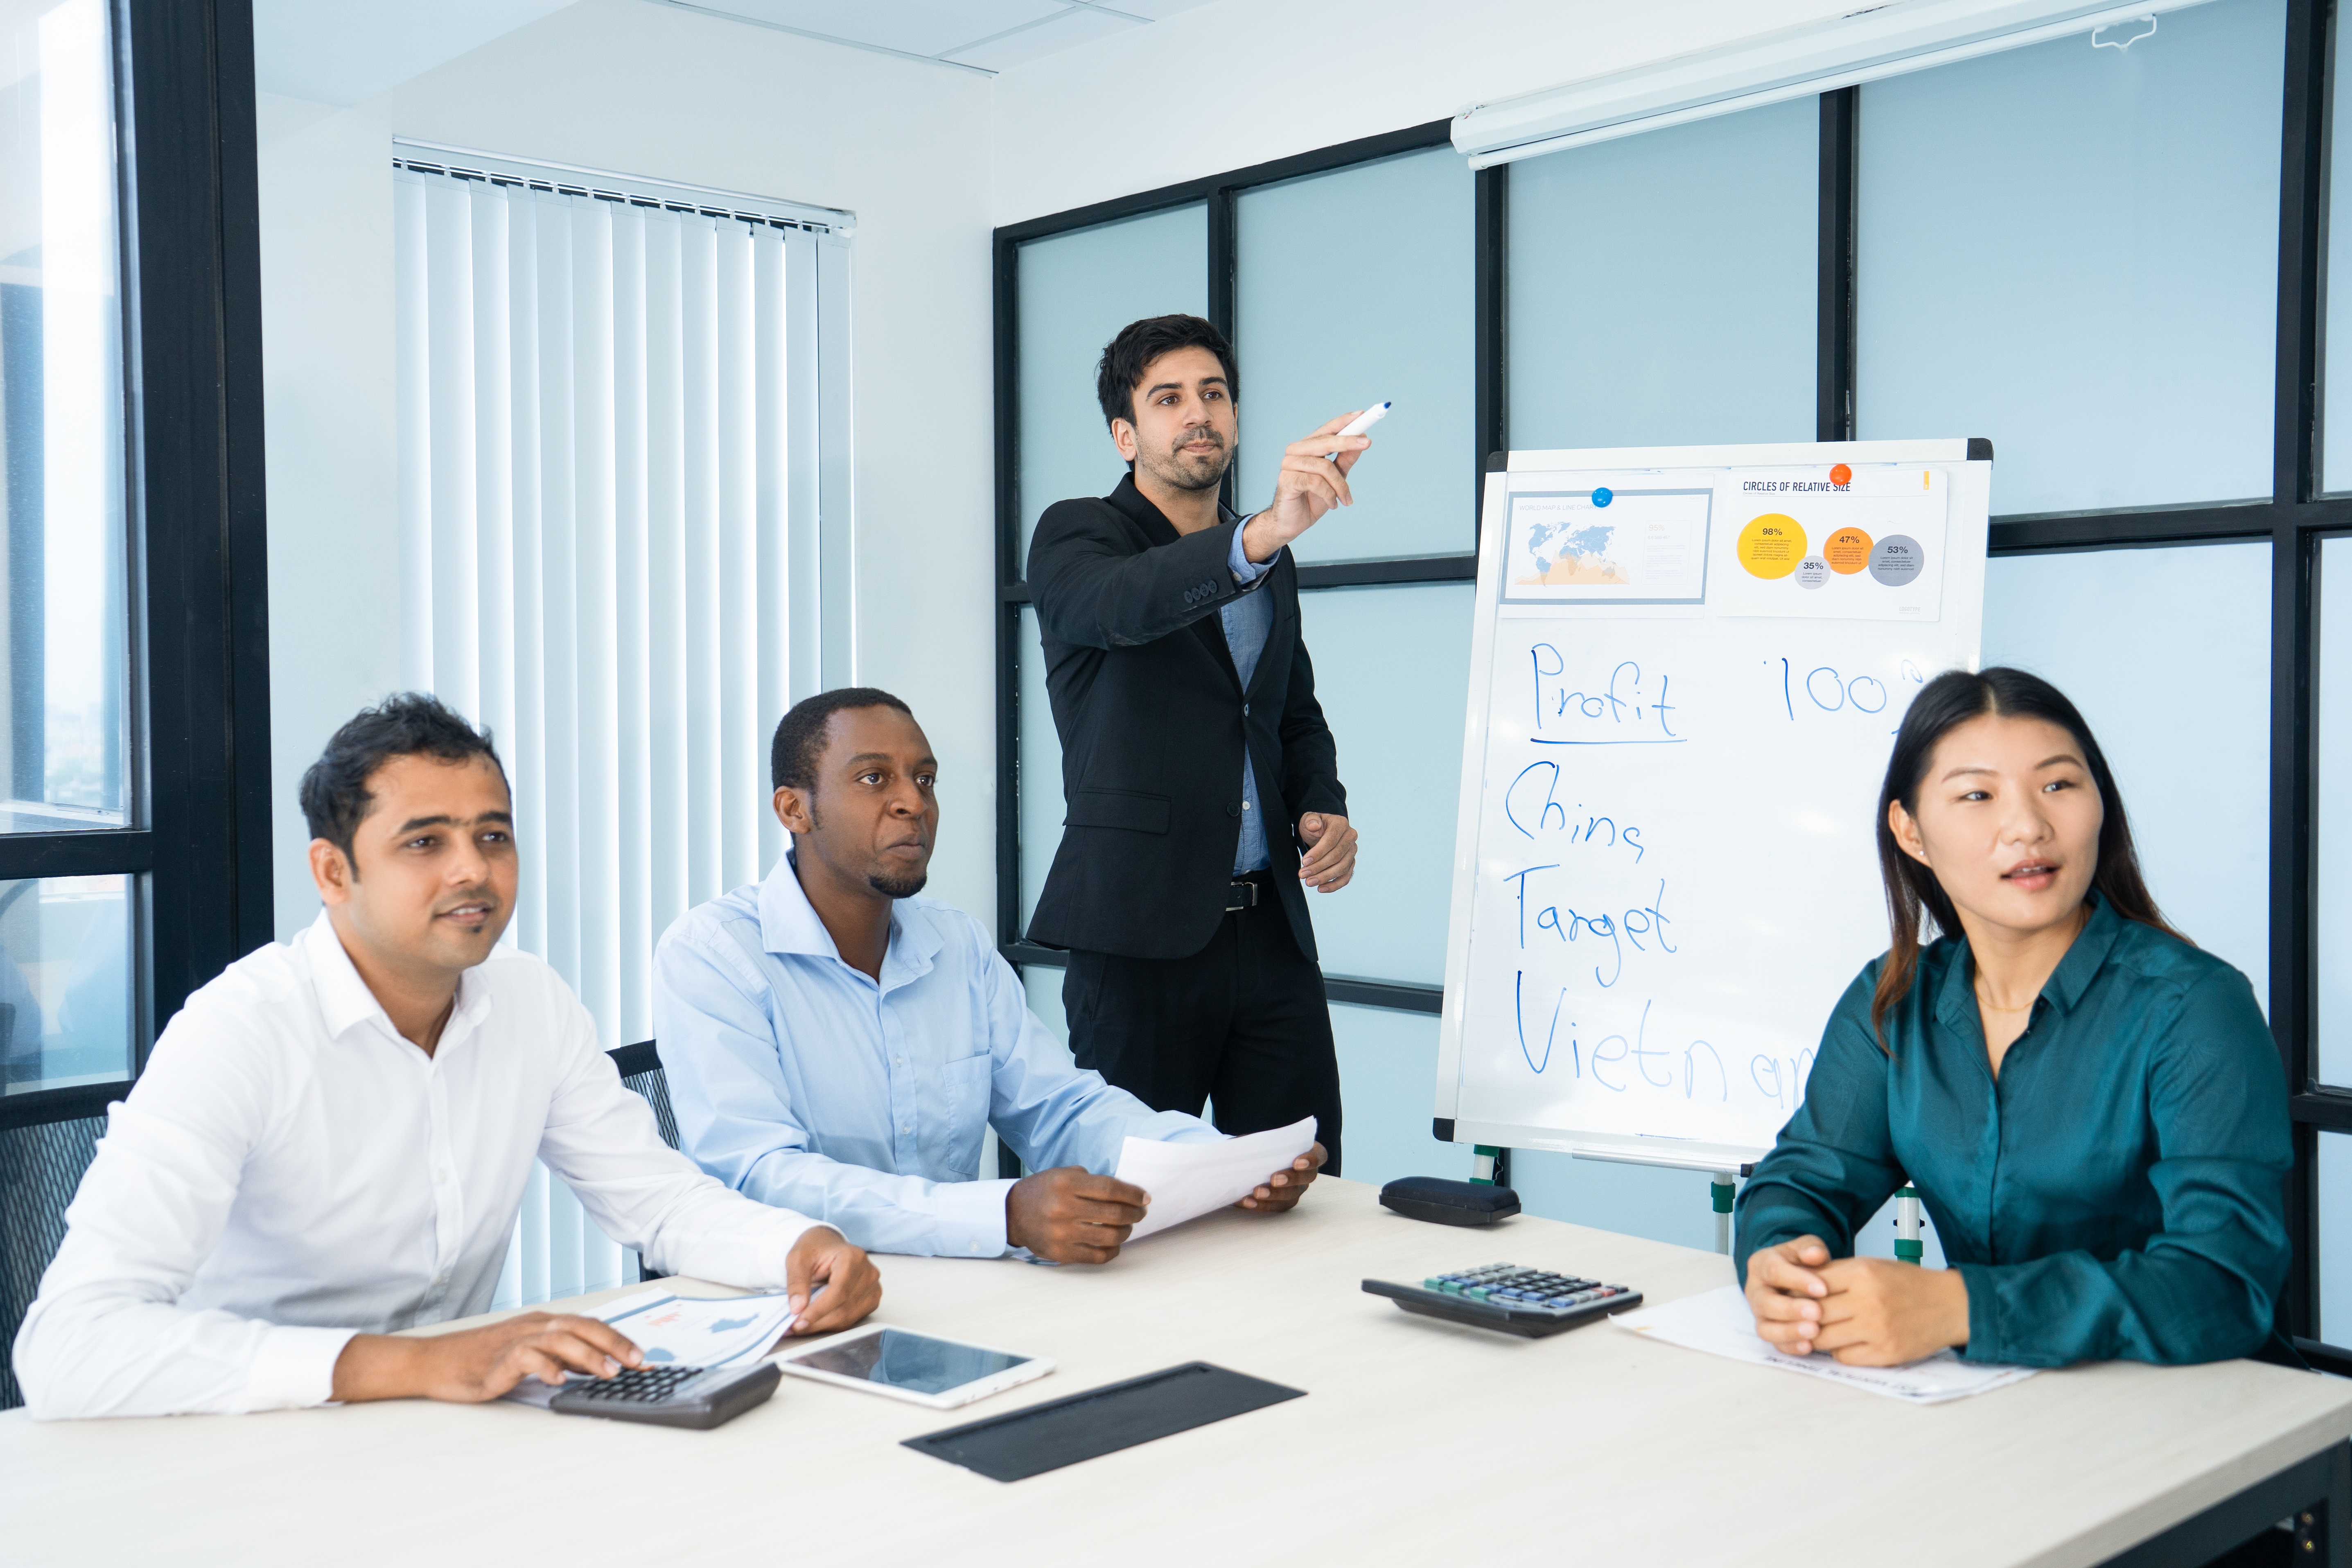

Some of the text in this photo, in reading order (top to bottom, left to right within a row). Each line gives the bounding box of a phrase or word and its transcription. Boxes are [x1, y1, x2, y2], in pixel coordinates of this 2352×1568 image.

[1743, 482, 1851, 491] CIRCLES OF RELATIVE SIZE
[1530, 643, 1676, 737] Profit
[1503, 864, 1677, 988] Target
